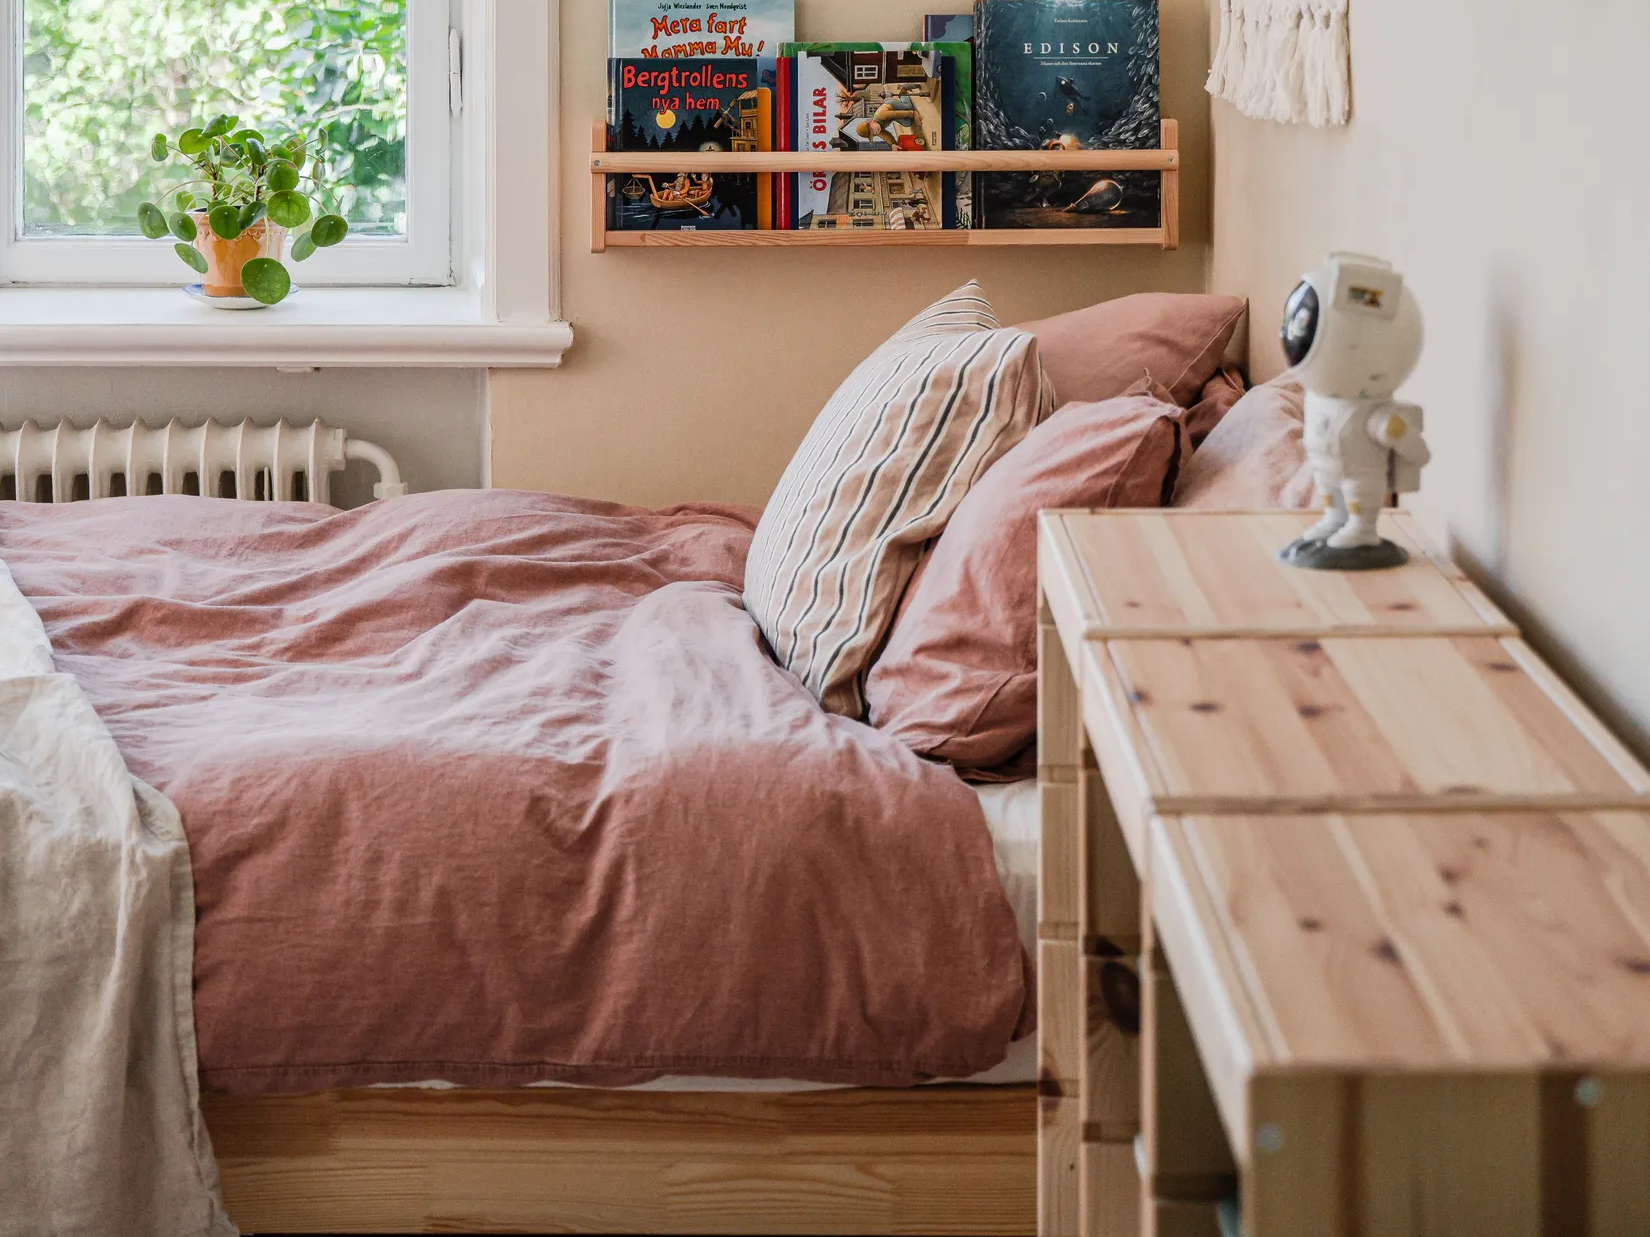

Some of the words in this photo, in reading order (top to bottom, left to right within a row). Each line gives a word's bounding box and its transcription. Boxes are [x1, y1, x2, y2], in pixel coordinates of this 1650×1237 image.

[658, 2, 671, 12] Jujja
[673, 2, 702, 10] Wieslander
[719, 2, 748, 11] Nordqvist
[650, 15, 702, 40] Mera
[707, 12, 747, 35] fart
[641, 41, 716, 59] Mamma
[1023, 42, 1119, 54] EDISON
[623, 64, 748, 95] Bergtrollens
[652, 96, 680, 115] nya
[685, 92, 721, 110] hem
[812, 87, 827, 134] BILAR
